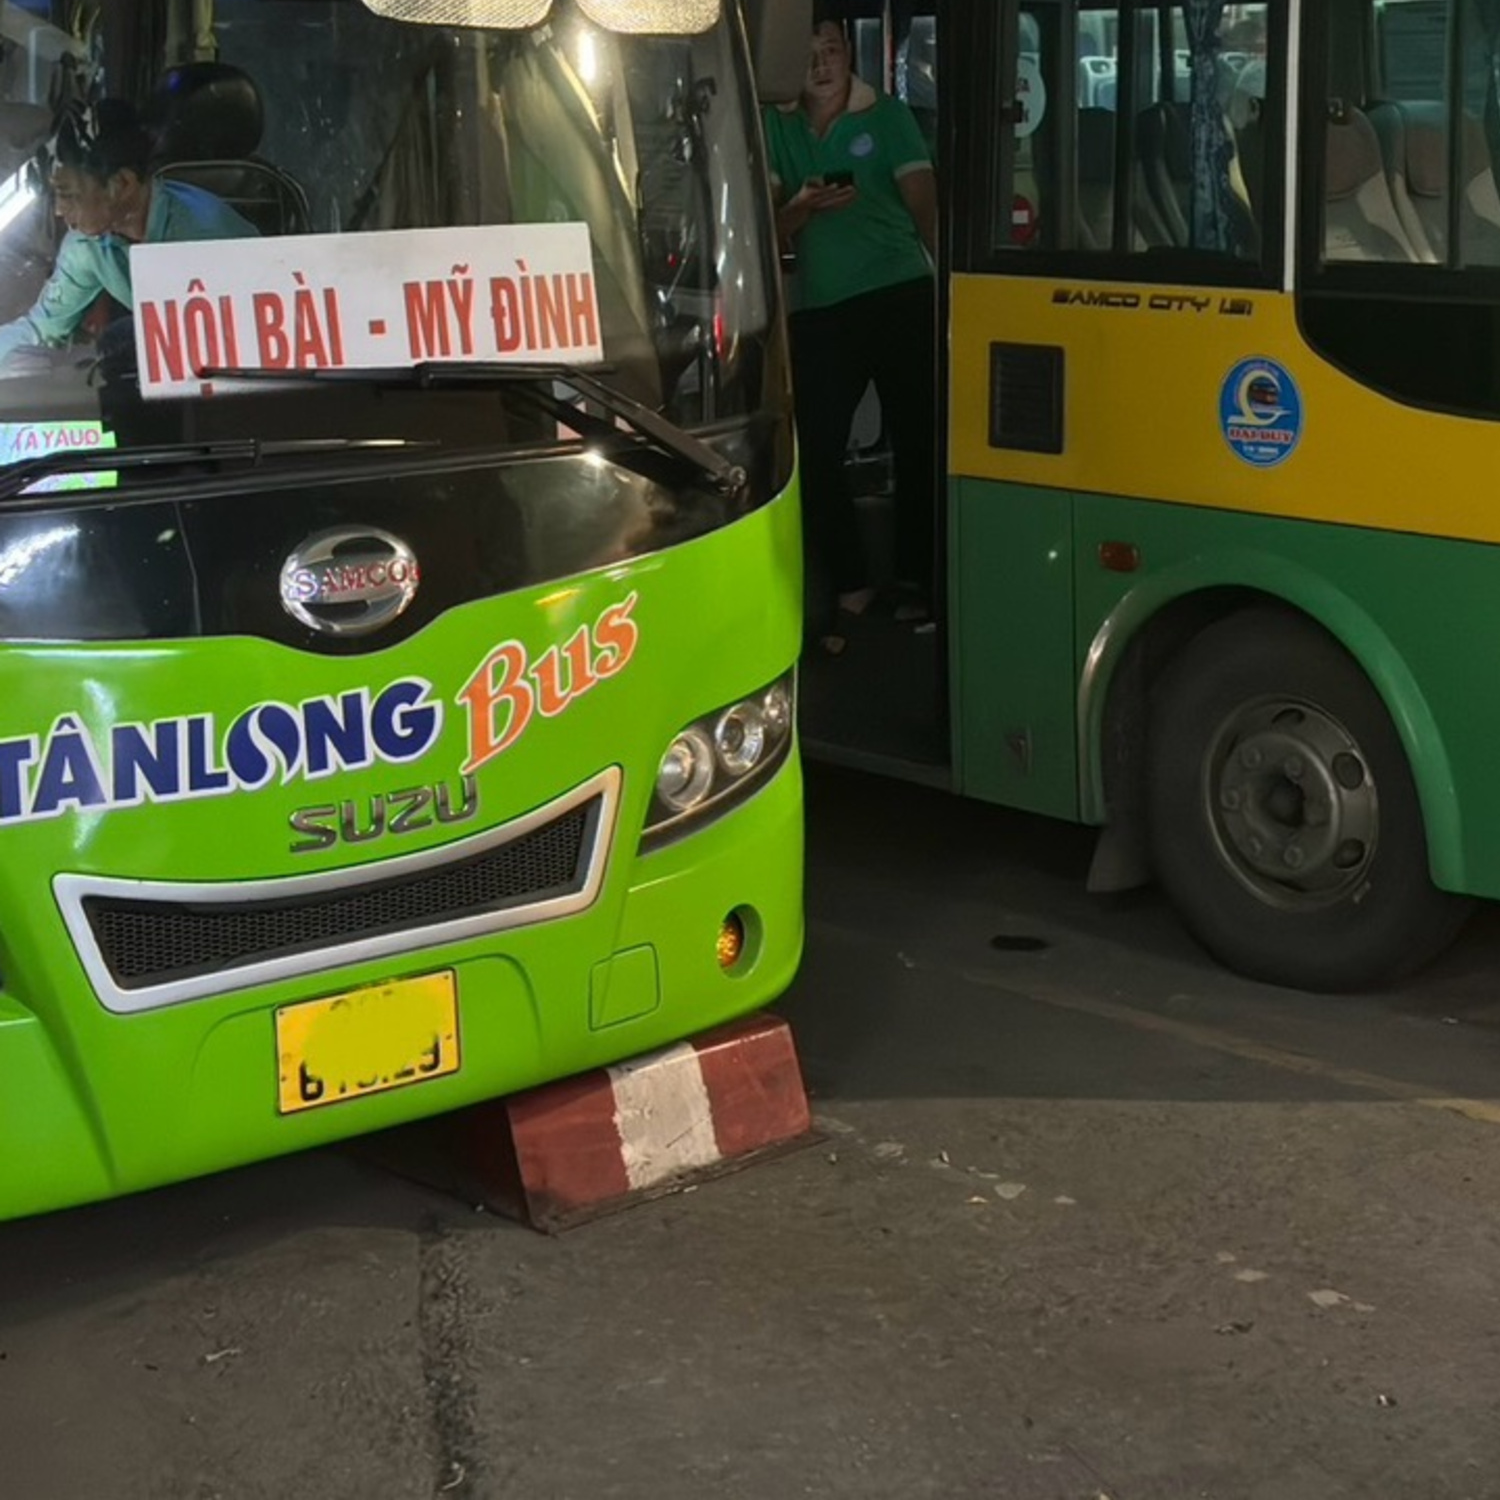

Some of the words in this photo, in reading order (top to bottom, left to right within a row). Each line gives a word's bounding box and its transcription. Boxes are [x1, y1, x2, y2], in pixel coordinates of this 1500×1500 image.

[140, 278, 241, 395] NỘI
[252, 271, 344, 372] BÀI
[403, 263, 474, 359] MỸ
[489, 259, 598, 352] ĐÌNH
[290, 558, 410, 600] SAMCO
[458, 592, 639, 775] Bus
[287, 775, 480, 855] SUZU
